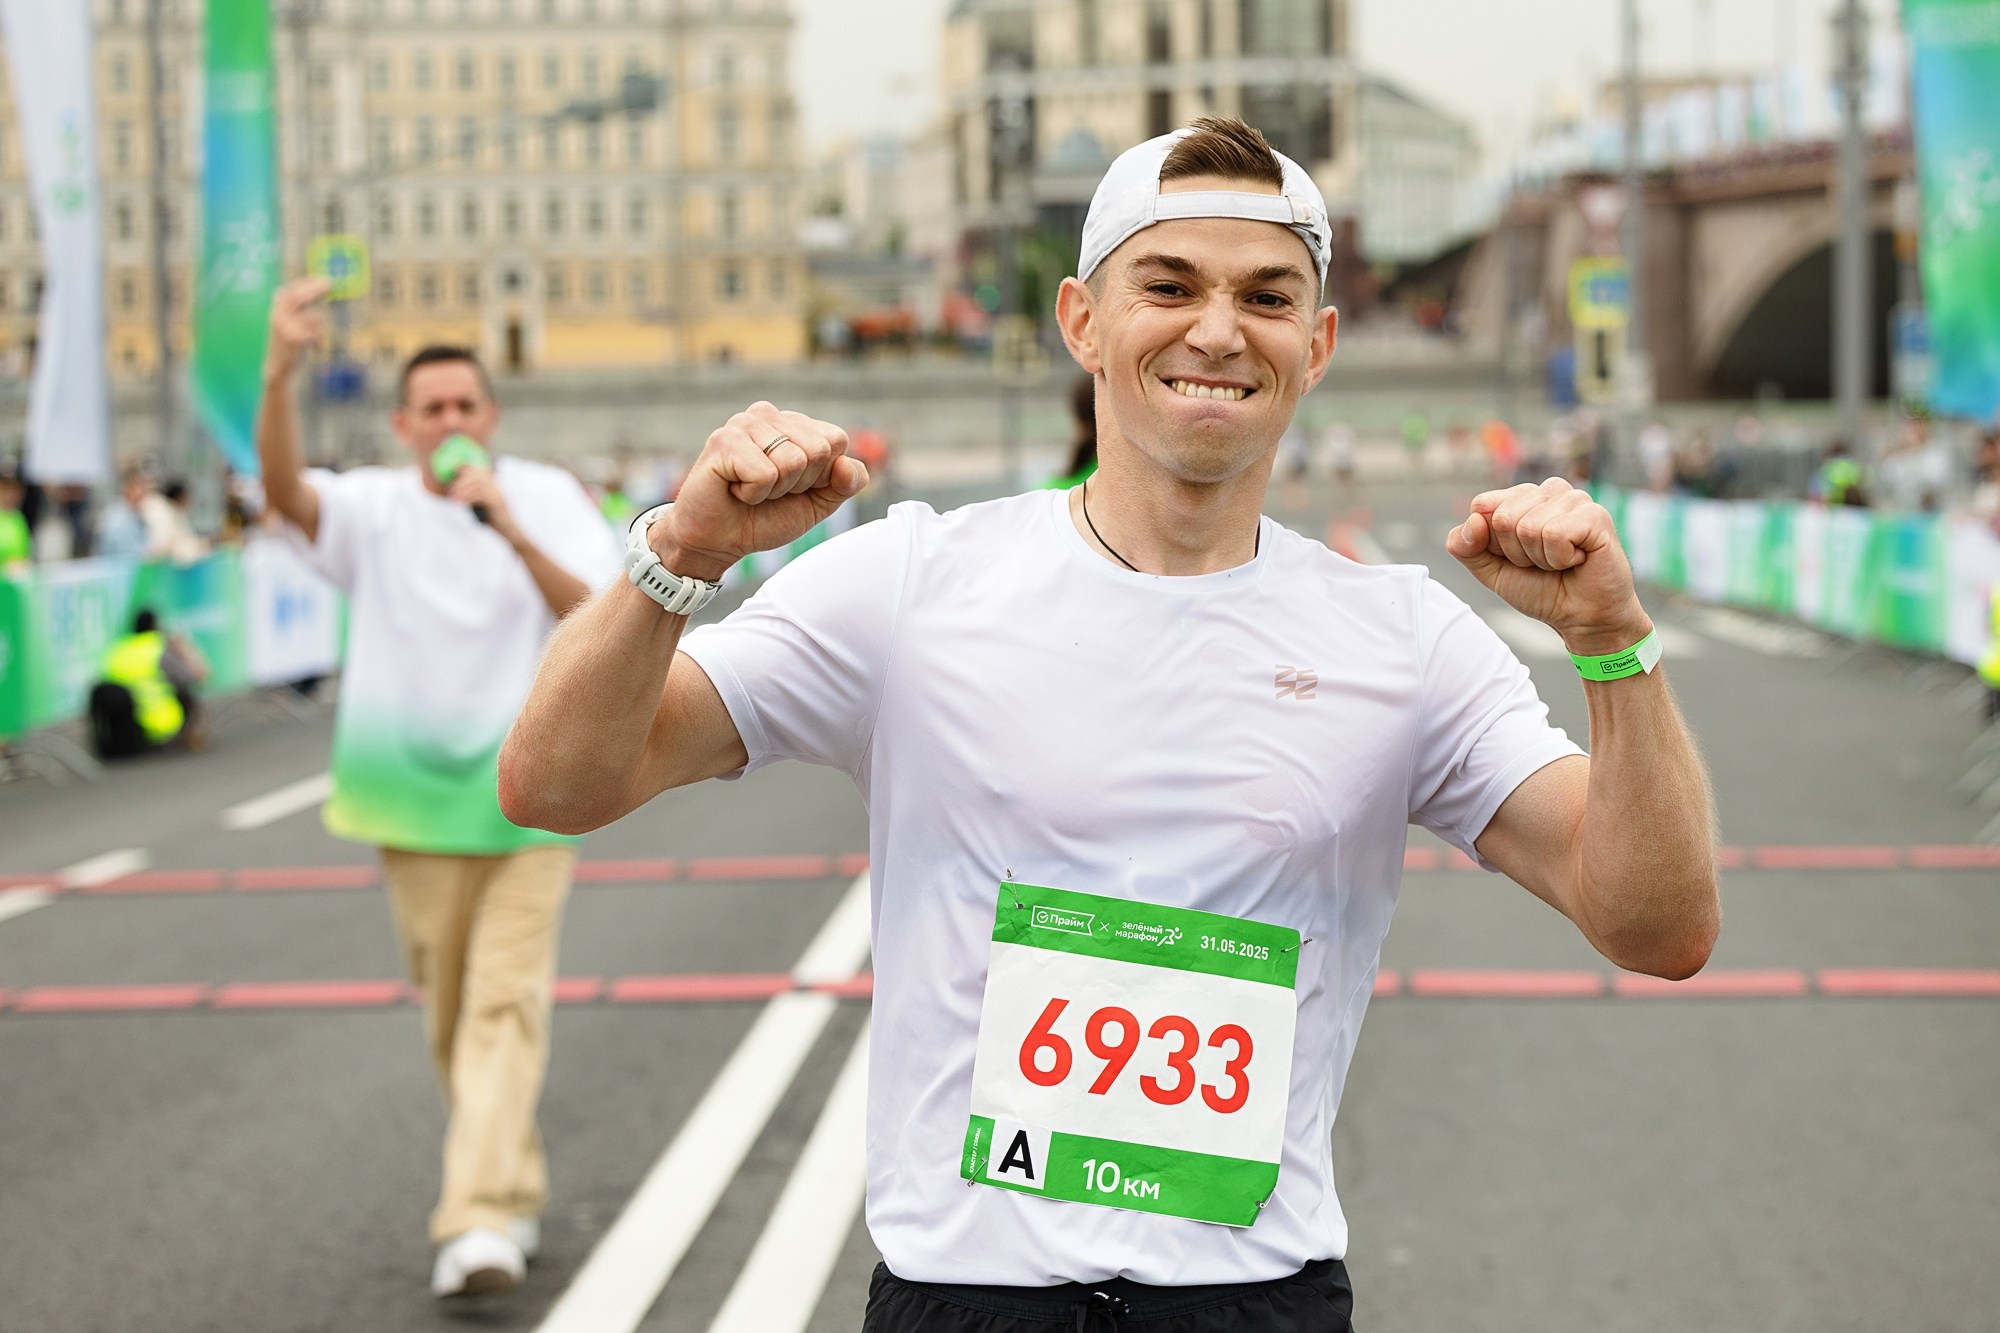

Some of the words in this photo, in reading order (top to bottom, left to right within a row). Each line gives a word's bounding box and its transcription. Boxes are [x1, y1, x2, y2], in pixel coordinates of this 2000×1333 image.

[1612, 657, 1635, 669] Прайм
[1050, 914, 1084, 928] Прайм
[1121, 921, 1163, 934] зелёный
[1115, 930, 1158, 943] марафон
[1200, 935, 1269, 960] 31.05.2025
[1019, 998, 1253, 1113] 6933
